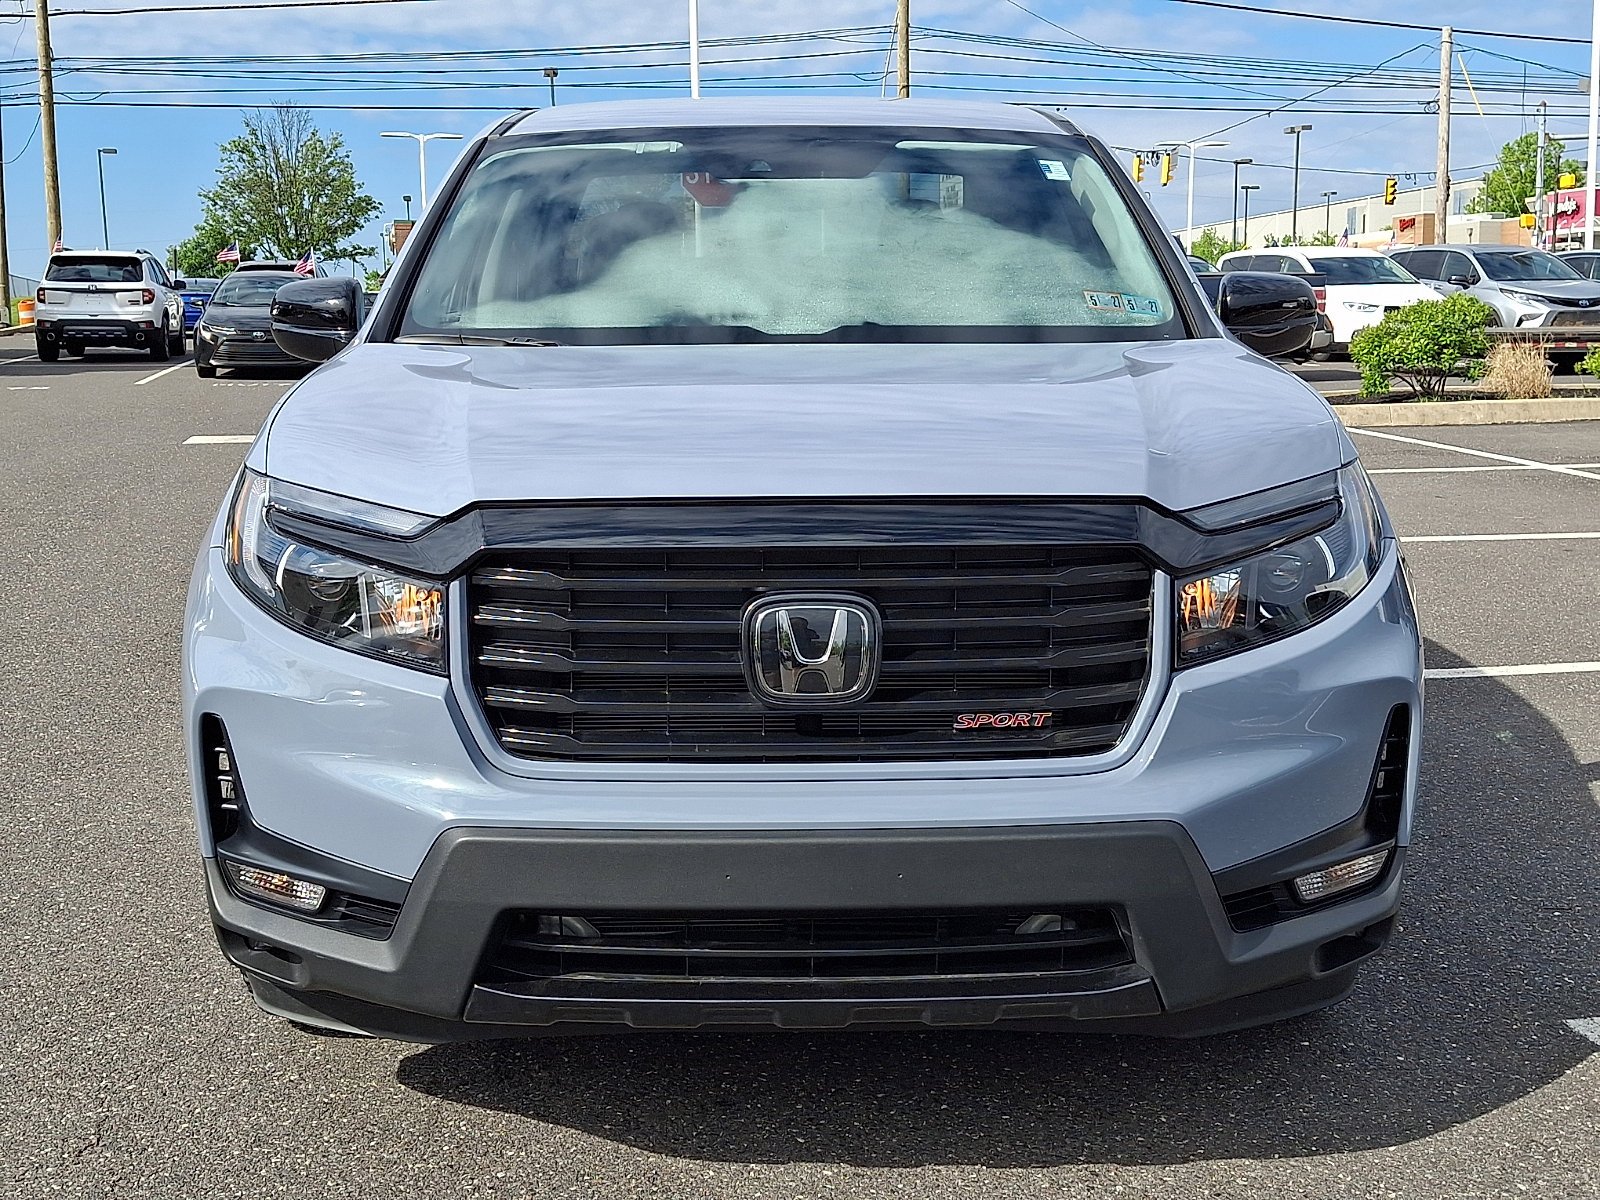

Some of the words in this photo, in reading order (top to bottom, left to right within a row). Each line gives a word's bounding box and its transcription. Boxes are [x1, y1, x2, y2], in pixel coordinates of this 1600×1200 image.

[1089, 295, 1098, 306] 5
[1127, 299, 1136, 311] 5
[953, 712, 1053, 729] SPORT
